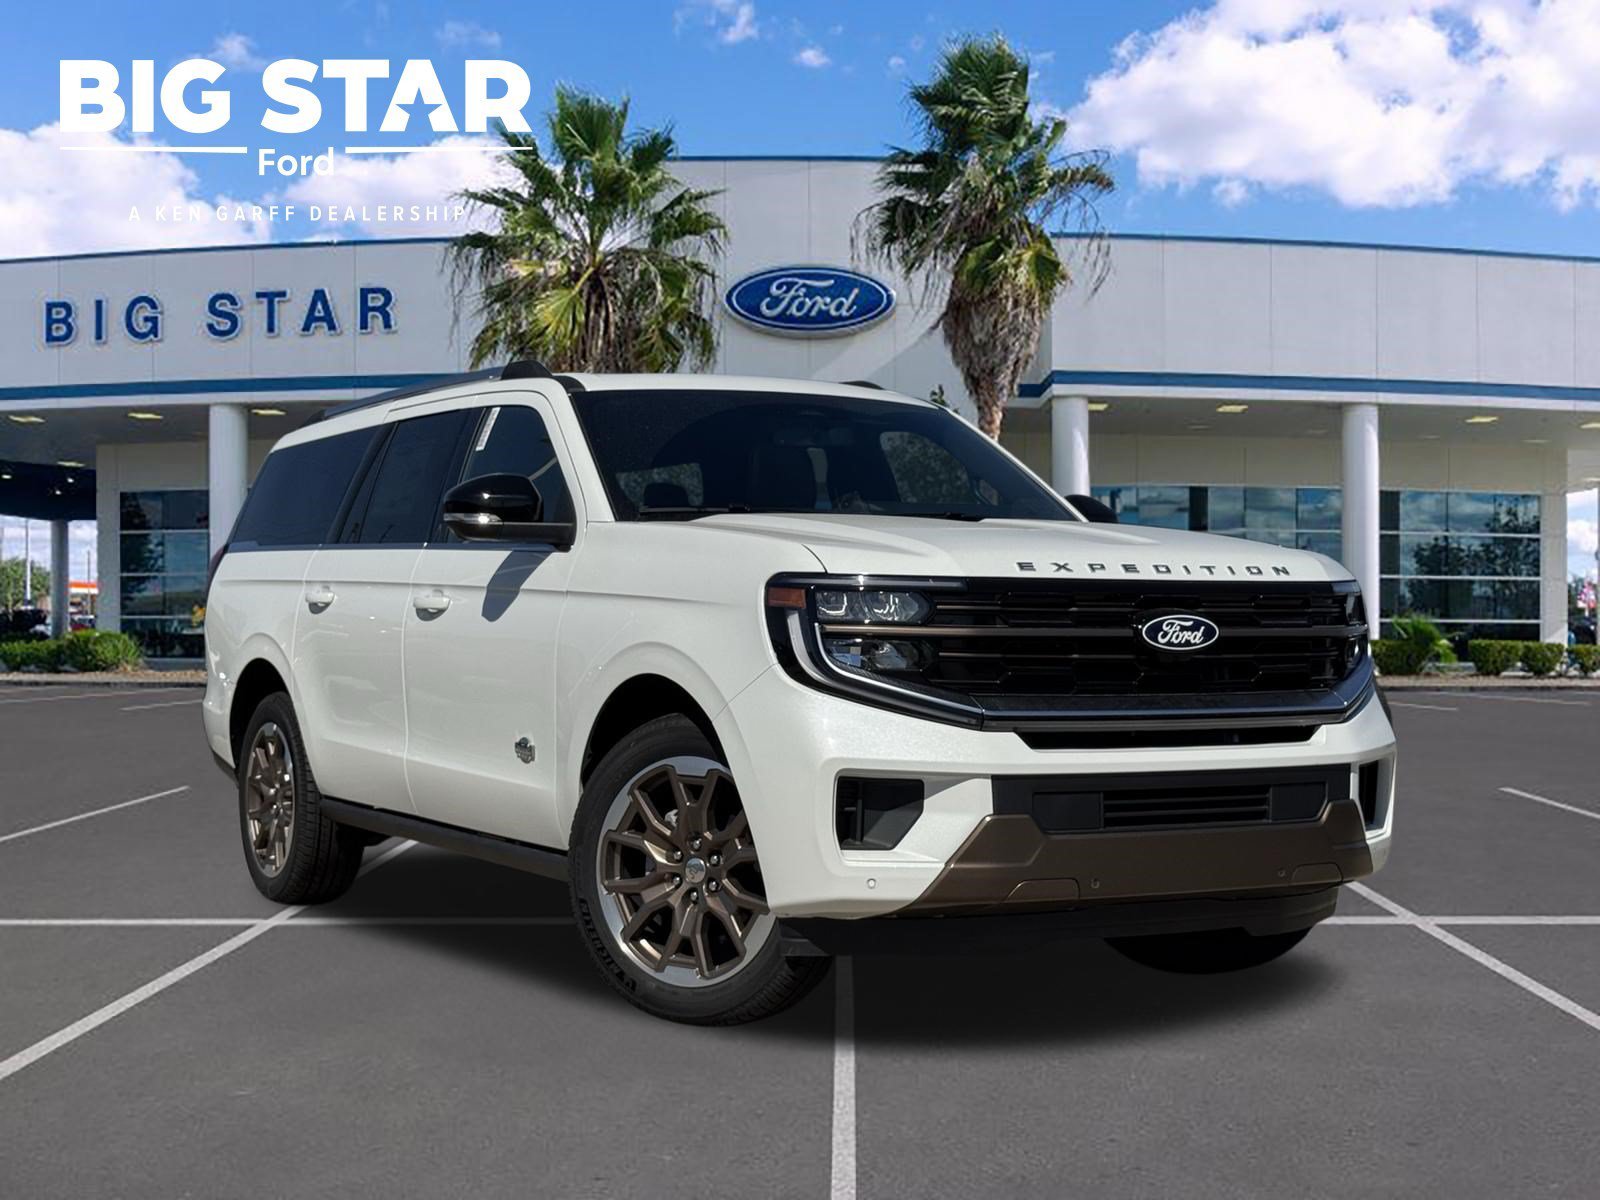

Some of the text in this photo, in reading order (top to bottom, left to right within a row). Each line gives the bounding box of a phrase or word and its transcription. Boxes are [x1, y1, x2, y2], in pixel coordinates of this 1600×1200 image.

[760, 277, 859, 317] Ford
[44, 286, 398, 344] BIG STAR
[1016, 562, 1290, 576] EXPEDITION
[1158, 620, 1205, 643] Ford
